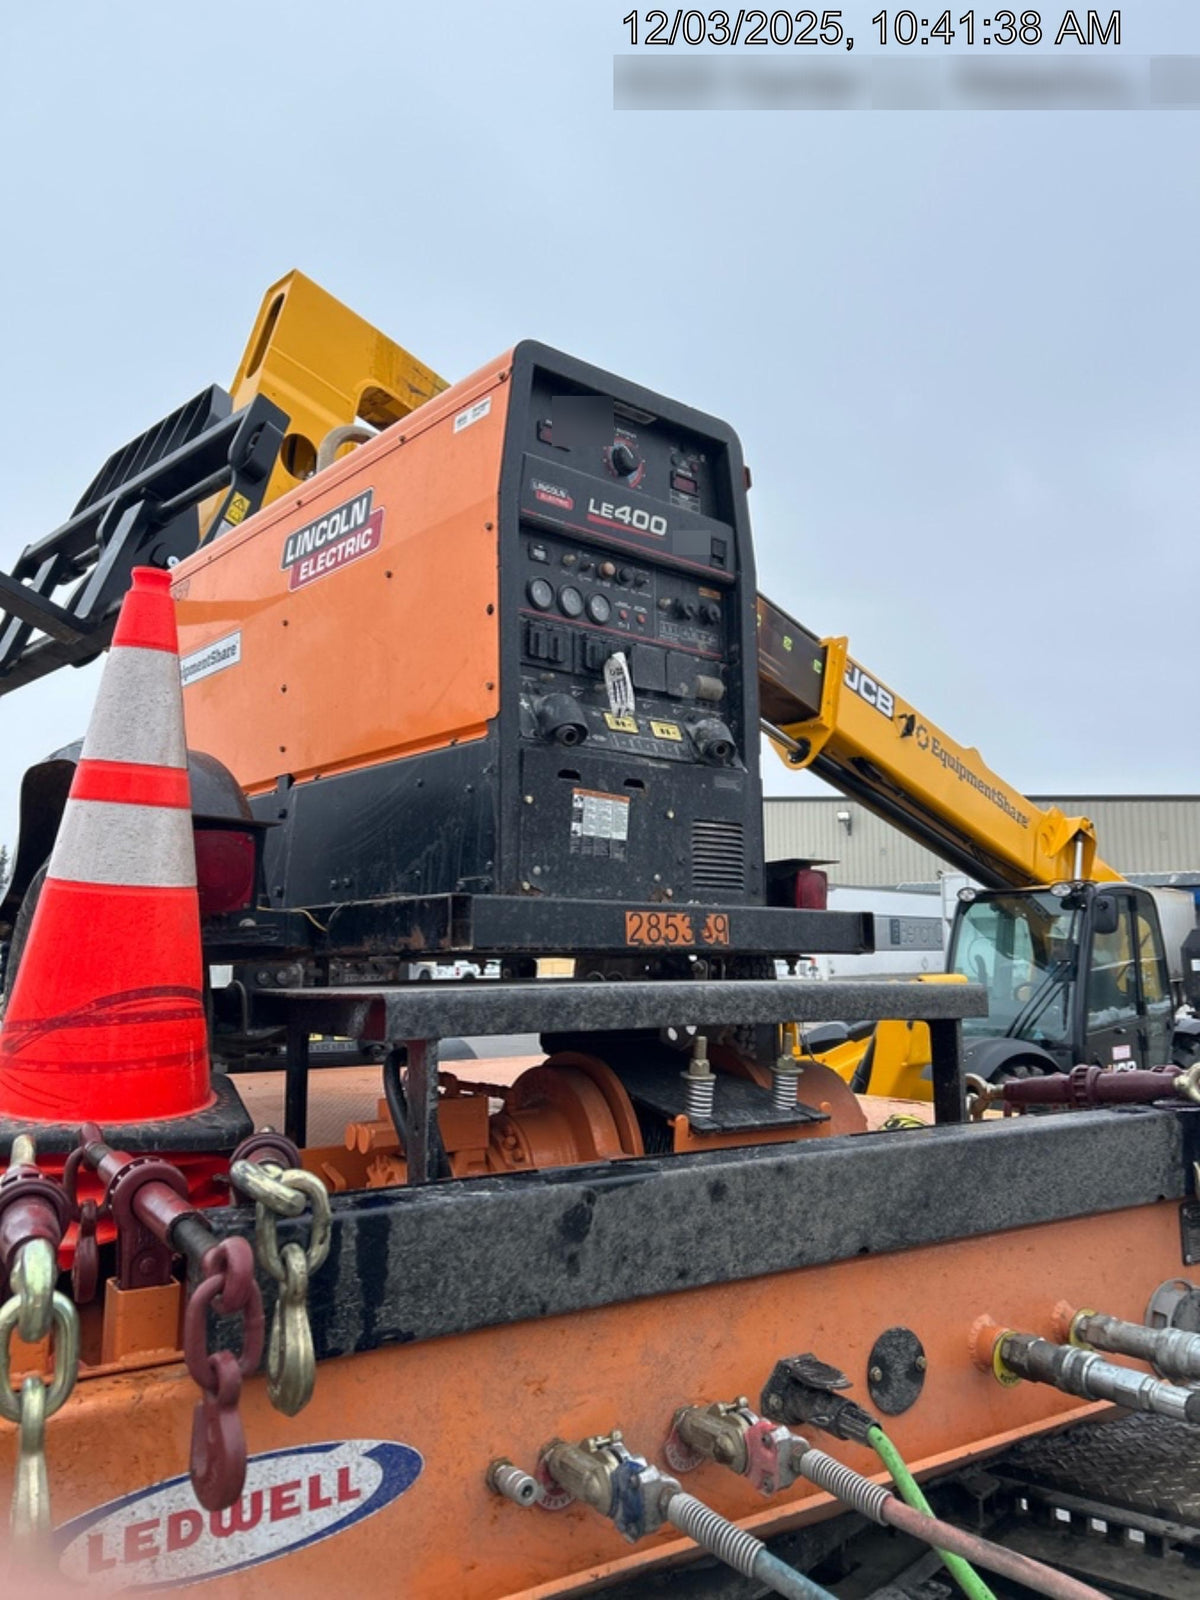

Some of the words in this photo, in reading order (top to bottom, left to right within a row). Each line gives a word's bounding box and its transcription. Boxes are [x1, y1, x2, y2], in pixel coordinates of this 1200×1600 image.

[285, 496, 368, 566] LINCOLN
[588, 498, 668, 537] LE400
[298, 528, 374, 582] ELECTRIC
[844, 666, 894, 718] JCB
[930, 736, 1029, 829] EquipmentShare
[87, 1466, 362, 1574] LEDWELL
